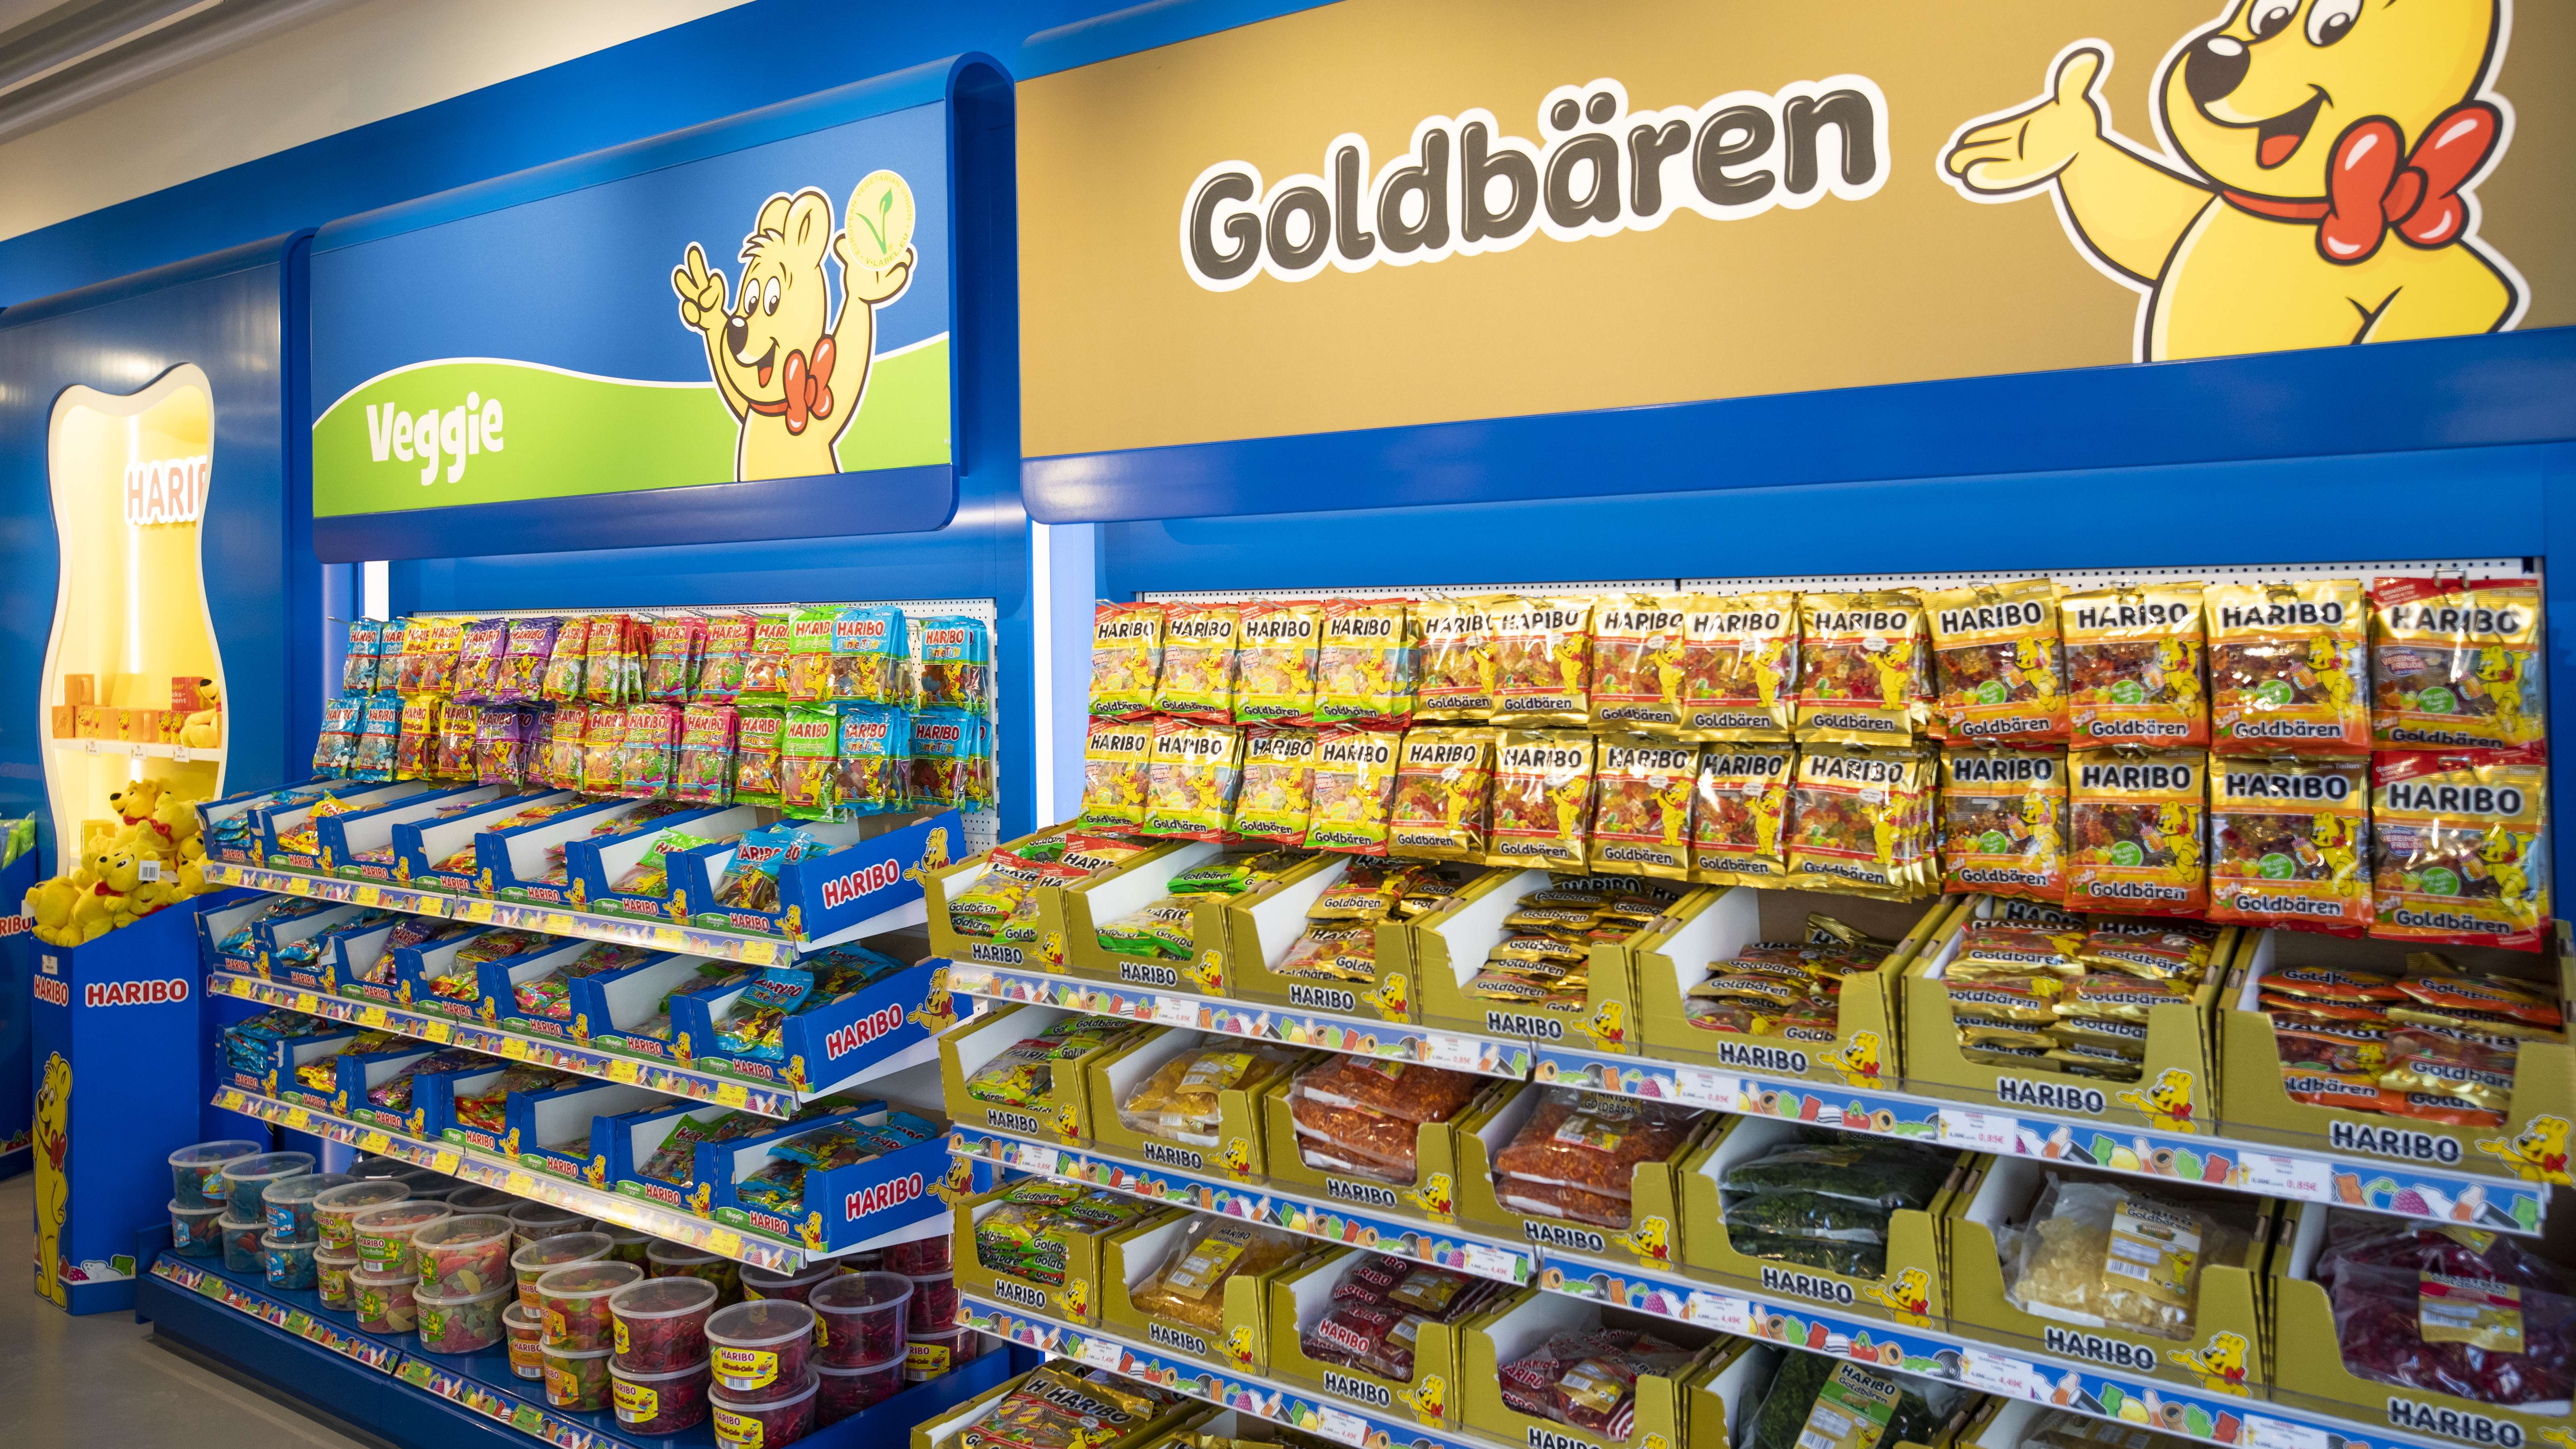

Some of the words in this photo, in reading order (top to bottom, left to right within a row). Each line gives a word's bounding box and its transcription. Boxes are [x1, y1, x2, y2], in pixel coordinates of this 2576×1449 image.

[857, 175, 900, 197] VEGETARIAN
[1190, 90, 1876, 279] Goldbären
[366, 392, 504, 486] Veggie
[128, 463, 207, 519] HARI
[2379, 584, 2414, 596] Gewinne
[1816, 613, 1907, 631] HARIBO
[1942, 602, 2041, 633] HARIBO
[2080, 603, 2188, 627] HARIBO
[2223, 602, 2342, 628] HARIBO
[2392, 606, 2519, 634] HARIBO
[838, 622, 884, 636] HARIBO
[1099, 622, 1155, 638] HARIBO
[1247, 620, 1311, 637] HARIBO
[1331, 619, 1391, 636] HARIBO
[926, 630, 964, 644] HARIBO
[1096, 701, 1144, 712] Goldbären
[1244, 706, 1301, 717] Goldbären
[1505, 698, 1571, 711] Goldbären
[479, 712, 512, 725] HARIBO
[1602, 709, 1672, 722] Goldbären
[1696, 714, 1770, 727] Goldbären
[1813, 715, 1893, 730] Goldbären
[789, 723, 828, 737] HARIBO
[916, 726, 959, 740] HARIBO
[2092, 721, 2187, 737] Goldbären
[2234, 723, 2341, 739] Goldbären
[1091, 735, 1145, 751] HARIBO
[2391, 729, 2503, 749] Goldbären
[1253, 740, 1313, 756] HARIBO
[1410, 745, 1476, 763] HARIBO
[1504, 750, 1581, 767] HARIBO
[1702, 754, 1782, 776] HARIBO
[1812, 758, 1904, 783] HARIBO
[1954, 759, 2052, 780] HARIBO
[2083, 766, 2190, 789] HARIBO
[2227, 775, 2349, 800] HARIBO
[2389, 784, 2521, 815] HARIBO
[1154, 820, 1207, 832] Goldbären
[1315, 831, 1372, 846] Goldbären
[289, 855, 314, 868] HARIBO
[1605, 848, 1672, 864] Goldbären
[362, 866, 388, 879] HARIBO
[1700, 858, 1768, 873] Goldbären
[441, 876, 470, 891] HARIBO
[824, 860, 898, 908] HARIBO
[1183, 871, 1231, 880] Goldbären
[1961, 870, 2046, 886] Goldbären
[528, 887, 559, 902] HARIBO
[2090, 883, 2186, 899] Goldbären
[623, 899, 658, 915] HARIBO
[1324, 898, 1381, 908] Goldbären
[2236, 897, 2340, 914] Goldbären
[0, 918, 32, 935] RIBO
[731, 914, 769, 931] HARIBO
[2396, 911, 2510, 934] Goldbären
[972, 944, 1023, 964] HARIBO
[1971, 951, 2065, 965] Goldbären
[1121, 963, 1177, 985] HARIBO
[35, 976, 68, 1006] HARIBO
[87, 981, 187, 1006] HARIBO
[364, 985, 390, 1000] HARIBO
[1478, 981, 1545, 997] Goldbären
[1711, 980, 1788, 996] Goldbären
[1291, 986, 1354, 1009] HARIBO
[530, 1019, 561, 1037] HARIBO
[1076, 1018, 1126, 1027] Goldbären
[1487, 1012, 1562, 1038] HARIBO
[827, 1005, 902, 1059] HARIBO
[627, 1037, 662, 1055] HARIBO
[1453, 1056, 1471, 1064] 0,85€
[1719, 1042, 1806, 1073] HARIBO
[733, 1059, 773, 1079] HARIBO
[1999, 1079, 2104, 1112] HARIBO
[376, 1112, 401, 1128] HARIBO
[988, 1111, 1038, 1133] HARIBO
[466, 1131, 495, 1149] HARIBO
[2331, 1122, 2458, 1162] HARIBO
[1144, 1143, 1203, 1169] HARIBO
[547, 1157, 578, 1176] HARIBO
[646, 1184, 681, 1205] HARIBO
[847, 1174, 921, 1220] HARIBO
[1014, 1191, 1059, 1201] Goldbären
[1327, 1180, 1396, 1205] HARIBO
[1072, 1205, 1119, 1222] Goldbären
[750, 1212, 788, 1235] HARIBO
[1218, 1228, 1251, 1239] HARIBO
[1525, 1222, 1603, 1251] HARIBO
[360, 1238, 384, 1247] HARIBO
[996, 1280, 1046, 1307] HARIBO
[1763, 1268, 1853, 1303] HARIBO
[1150, 1324, 1205, 1353] HARIBO
[1321, 1321, 1369, 1351] HARIBO
[721, 1350, 755, 1361] HARIBO
[909, 1346, 930, 1355] RIBO
[2047, 1328, 2154, 1370] HARIBO
[1841, 1365, 1895, 1395] HARIBO
[1325, 1373, 1390, 1405] HARIBO
[1046, 1386, 1131, 1422] HARIBO
[716, 1413, 741, 1426] HARIBO
[2389, 1398, 2520, 1447] HARIBO
